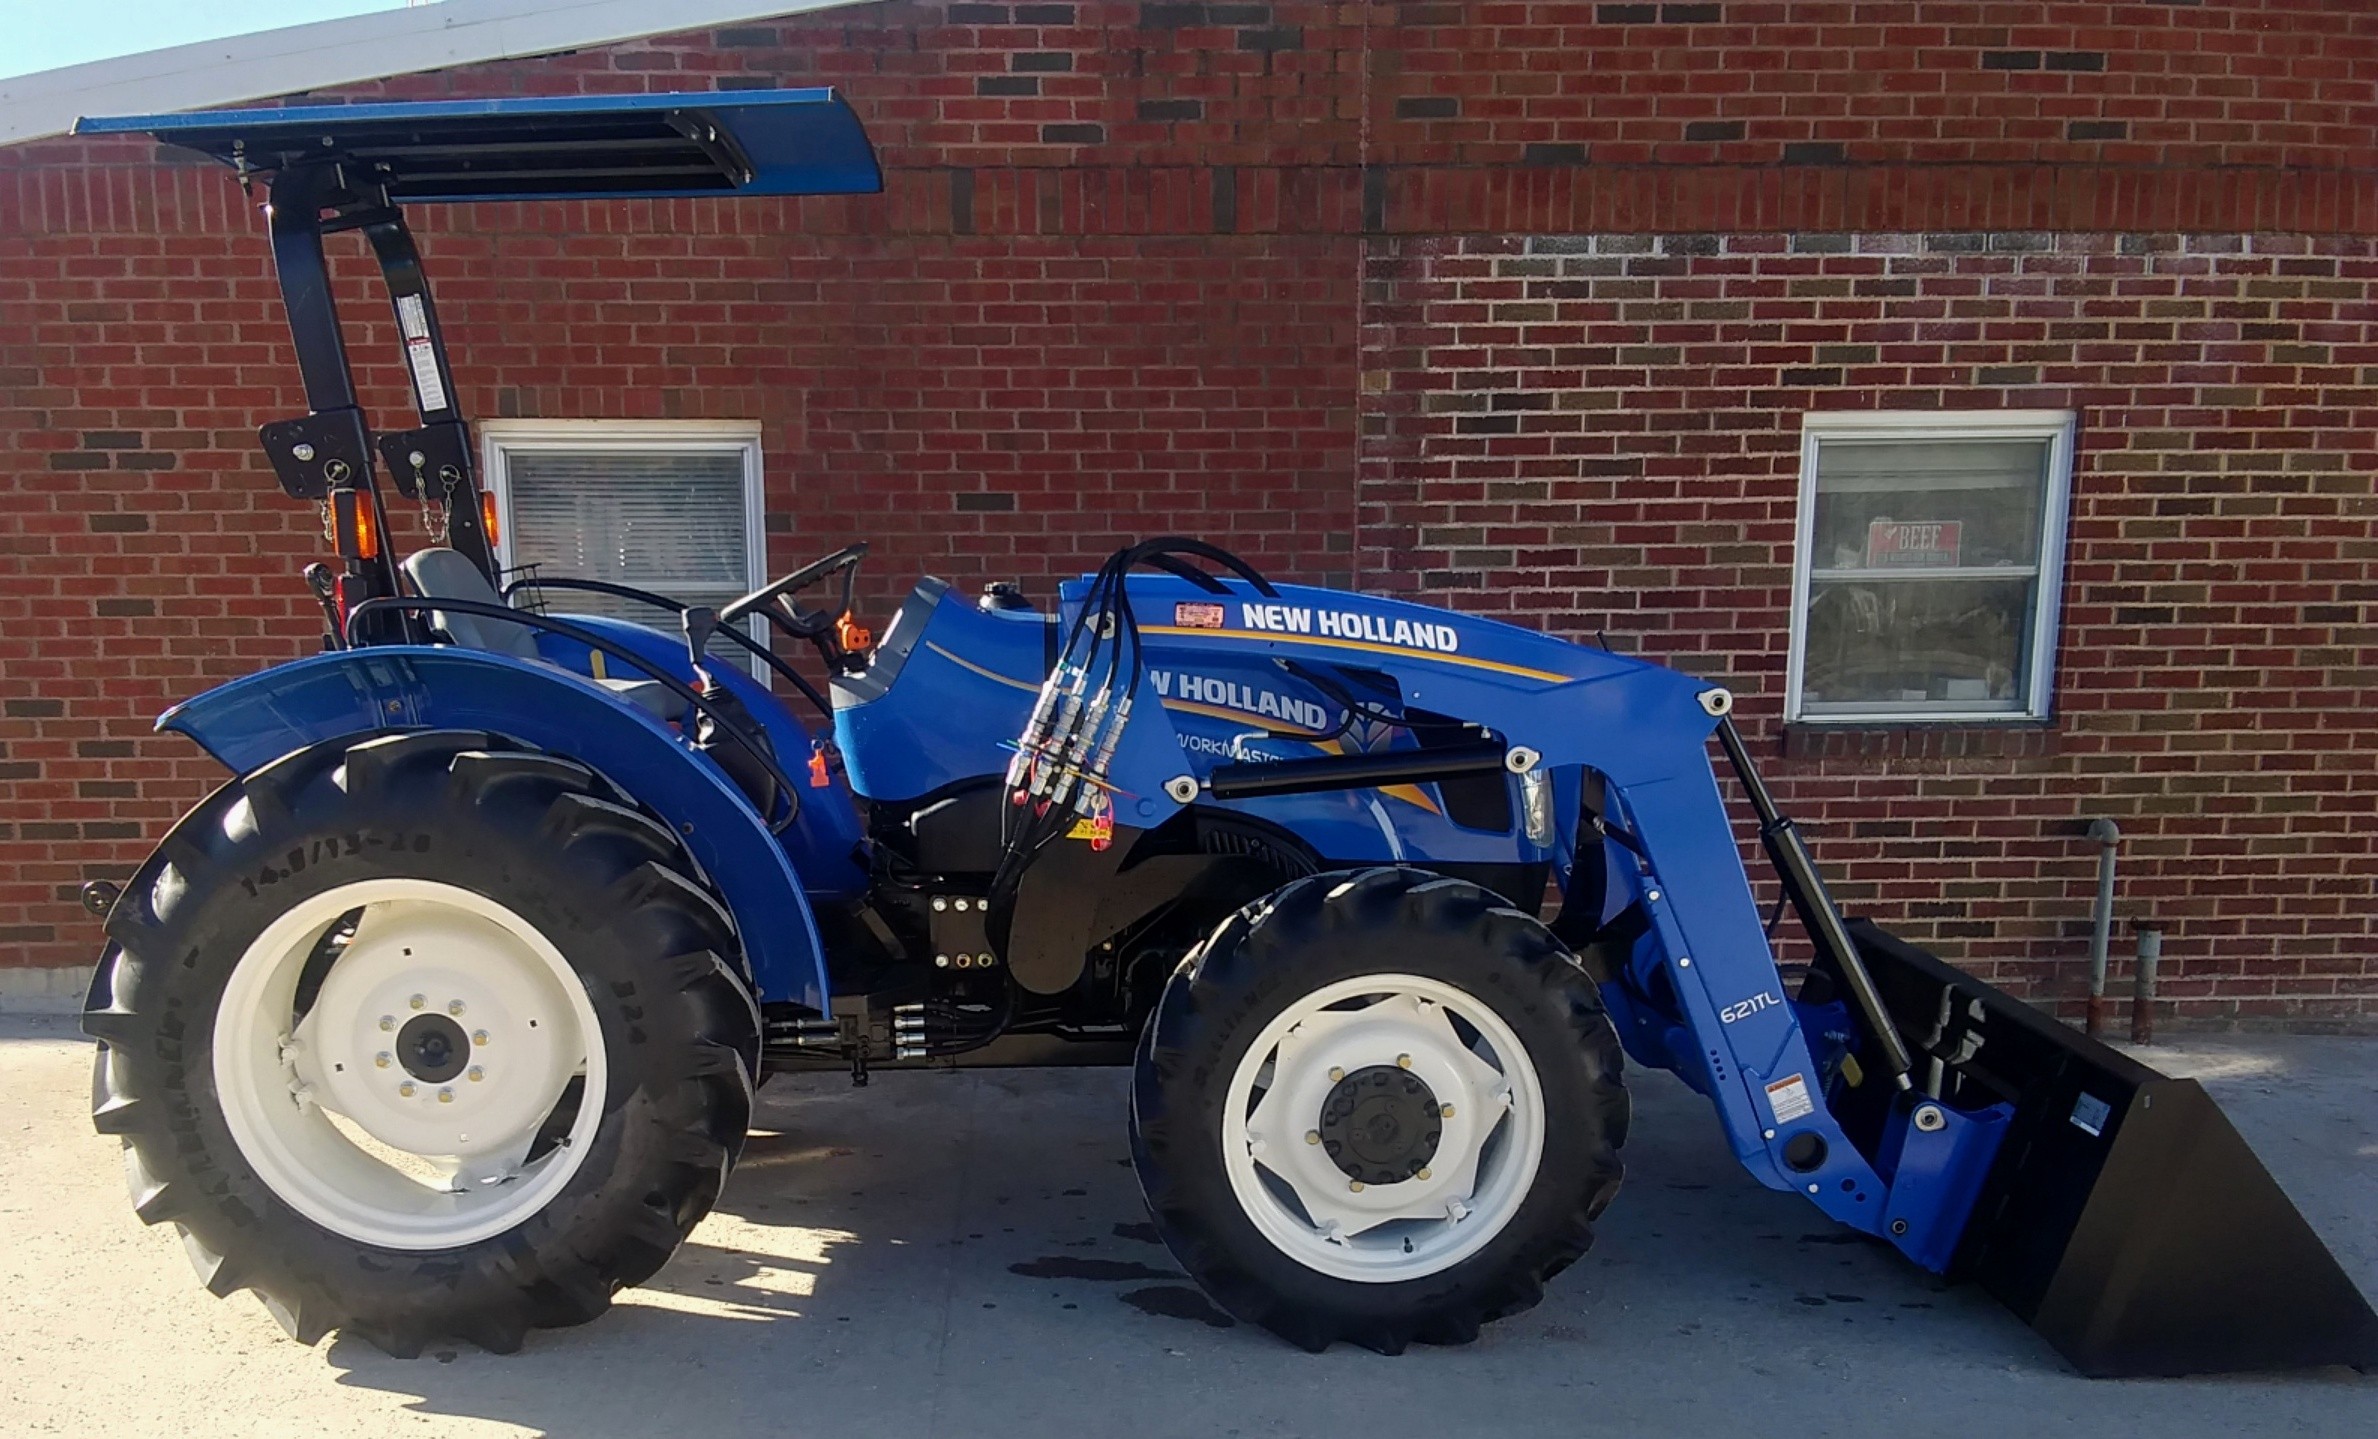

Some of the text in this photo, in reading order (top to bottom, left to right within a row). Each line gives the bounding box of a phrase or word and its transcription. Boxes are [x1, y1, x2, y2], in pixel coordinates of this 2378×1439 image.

[1899, 525, 1943, 550] BEEF
[1242, 603, 1311, 633] NEW
[1318, 609, 1459, 653] HOLLAND
[1180, 676, 1327, 730] HOLLAND
[1177, 732, 1285, 764] WORKMAST
[1720, 991, 1781, 1025] 621TL
